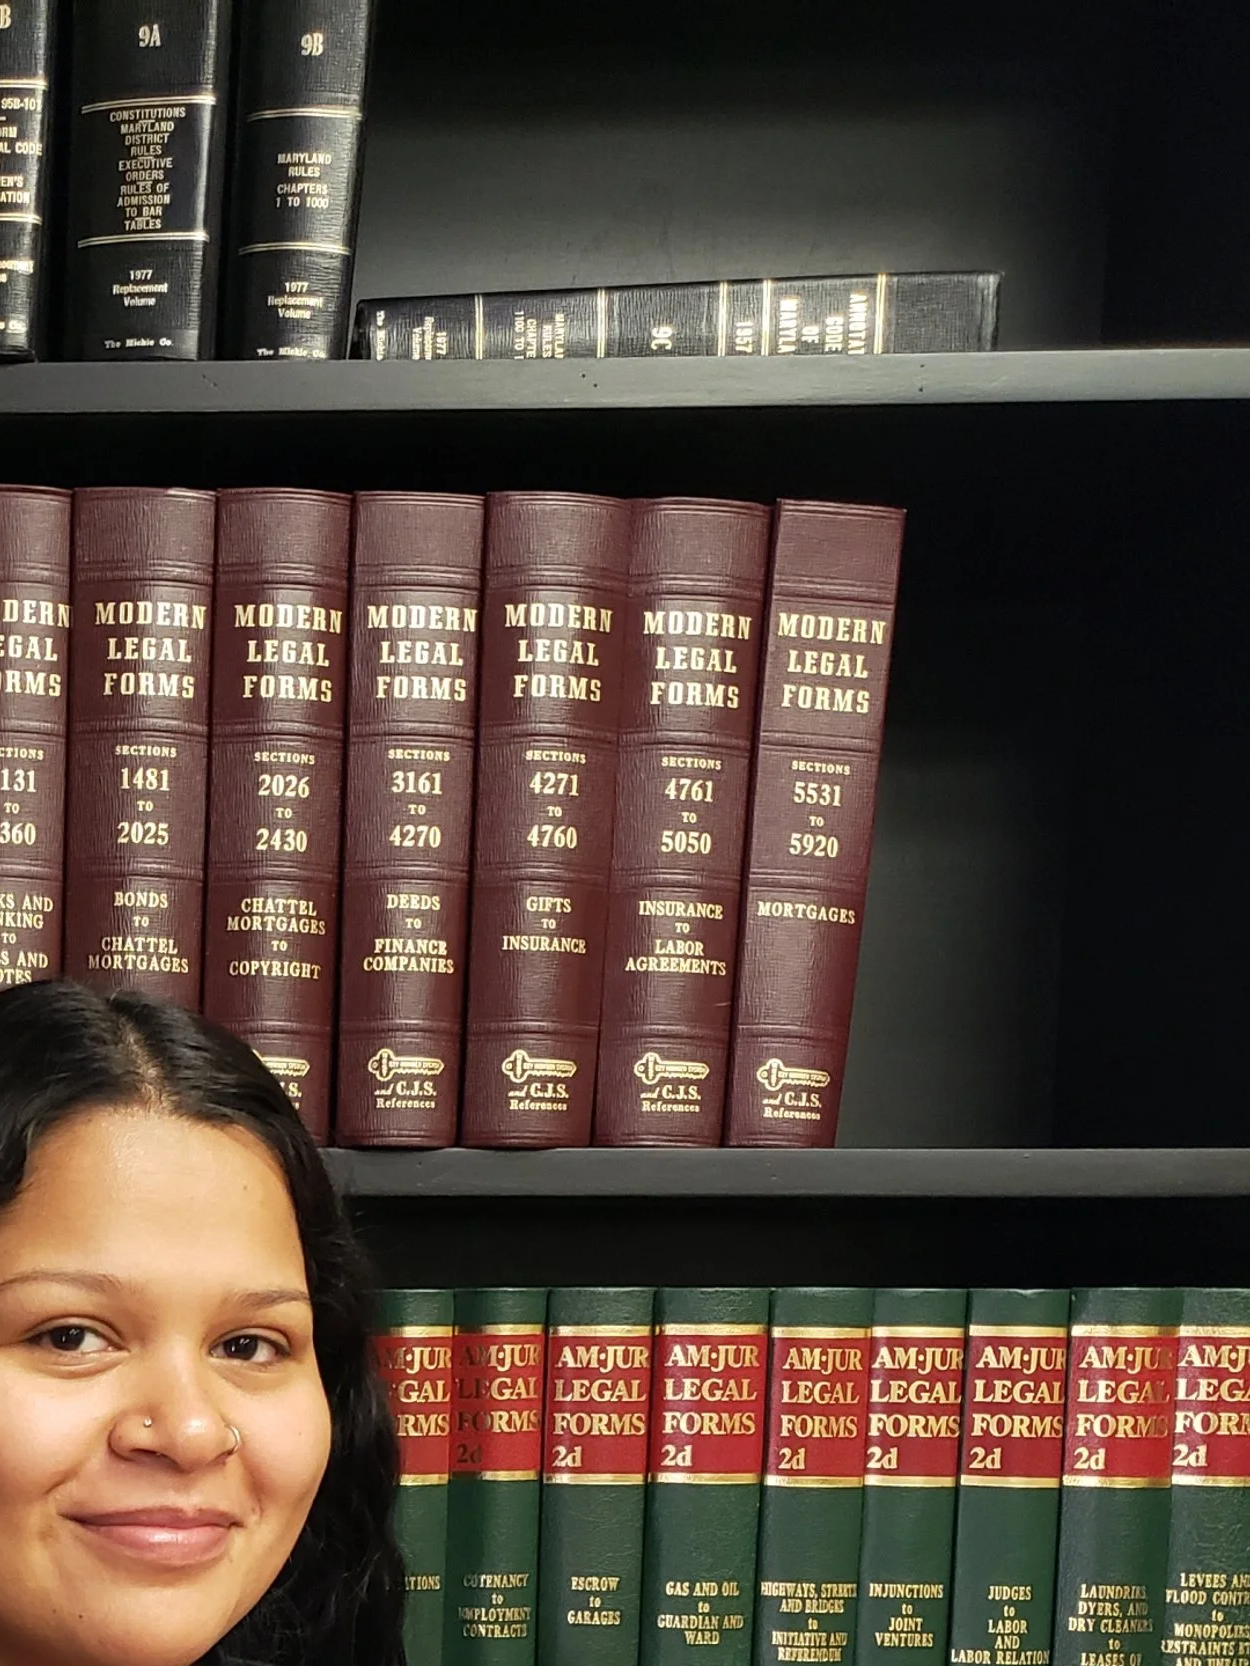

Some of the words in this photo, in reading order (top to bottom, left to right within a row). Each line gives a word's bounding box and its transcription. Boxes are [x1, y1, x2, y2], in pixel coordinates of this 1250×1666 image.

[139, 24, 160, 47] 9A
[301, 33, 323, 55] 9B
[110, 107, 186, 122] CONSTITUTIONS
[121, 120, 174, 134] MARYLAND
[125, 133, 169, 145] DISTRICT
[131, 145, 161, 156] RULES
[278, 153, 331, 164] MARYLAND
[119, 157, 172, 171] EXECUTIVE
[289, 167, 320, 177] RULES
[126, 170, 164, 181] ORDERS
[121, 181, 152, 195] RULES
[157, 183, 169, 192] OF
[277, 183, 327, 194] CHAPTERS
[117, 194, 170, 207] ADMISSION
[126, 208, 137, 217] TO
[143, 206, 162, 216] BAR
[288, 197, 300, 206] TO
[307, 197, 328, 209] 1000
[125, 217, 161, 230] TABLES
[130, 270, 152, 279] 1977
[651, 326, 672, 349] 9C
[736, 321, 753, 352] 1957
[96, 602, 206, 629] MODERN
[235, 604, 342, 633] MODERN
[368, 606, 477, 632] MODERN
[505, 604, 612, 632] MODERN
[644, 611, 752, 639] MODERN
[778, 613, 886, 644] MODERN
[107, 638, 191, 663] LEGAL
[247, 640, 329, 666] LEGAL
[380, 641, 463, 666] LEGAL
[518, 639, 598, 666] LEGAL
[655, 646, 736, 673] LEGAL
[788, 650, 868, 678] LEGAL
[104, 673, 194, 698] FORMS
[243, 676, 331, 702] FORMS
[376, 676, 466, 701] FORMS
[513, 675, 601, 701] FORMS
[650, 682, 738, 708] FORMS
[782, 684, 869, 713] FORMS
[121, 768, 169, 791] 1481
[258, 774, 309, 798] 2026
[392, 771, 442, 794] 3161
[530, 772, 578, 796] 4271
[665, 778, 713, 802] 4761
[794, 782, 840, 806] 5531
[118, 822, 168, 845] 2025
[256, 828, 307, 852] 2430
[389, 825, 440, 847] 4270
[527, 825, 577, 848] 4760
[661, 831, 711, 854] 5050
[790, 833, 838, 857] 5920
[114, 892, 168, 908] BONDS
[387, 894, 440, 910] DEEDS
[526, 897, 571, 912] GIFTS
[757, 901, 855, 924] MORTGAGES
[502, 936, 585, 953] INSURANCE
[655, 940, 703, 955] LABOR
[230, 961, 320, 979] COPYRIGHT
[364, 957, 454, 973] COMPANIES
[554, 1380, 646, 1401] LEGAL
[664, 1378, 757, 1401] LEGAL
[782, 1381, 859, 1403] LEGAL
[870, 1379, 961, 1403] LEGAL
[554, 1413, 645, 1435] FORMS
[663, 1412, 755, 1434] FORMS
[780, 1415, 857, 1437] FORMS
[869, 1414, 959, 1437] FORMS
[553, 1446, 581, 1466] 2d
[661, 1445, 691, 1466] 2d
[779, 1448, 805, 1469] 2d
[867, 1446, 897, 1468] 2d
[969, 1447, 1001, 1468] 2d
[1074, 1447, 1105, 1469] 2d
[571, 1577, 619, 1591] ESCROW
[869, 1583, 943, 1598] INJUNCTIONS
[988, 1586, 1031, 1600] JUDGES
[568, 1611, 620, 1624] GARAGES
[889, 1618, 923, 1631] JOINT
[988, 1620, 1027, 1633] LABOR
[685, 1631, 719, 1644] WARD
[875, 1632, 933, 1647] VENTURES
